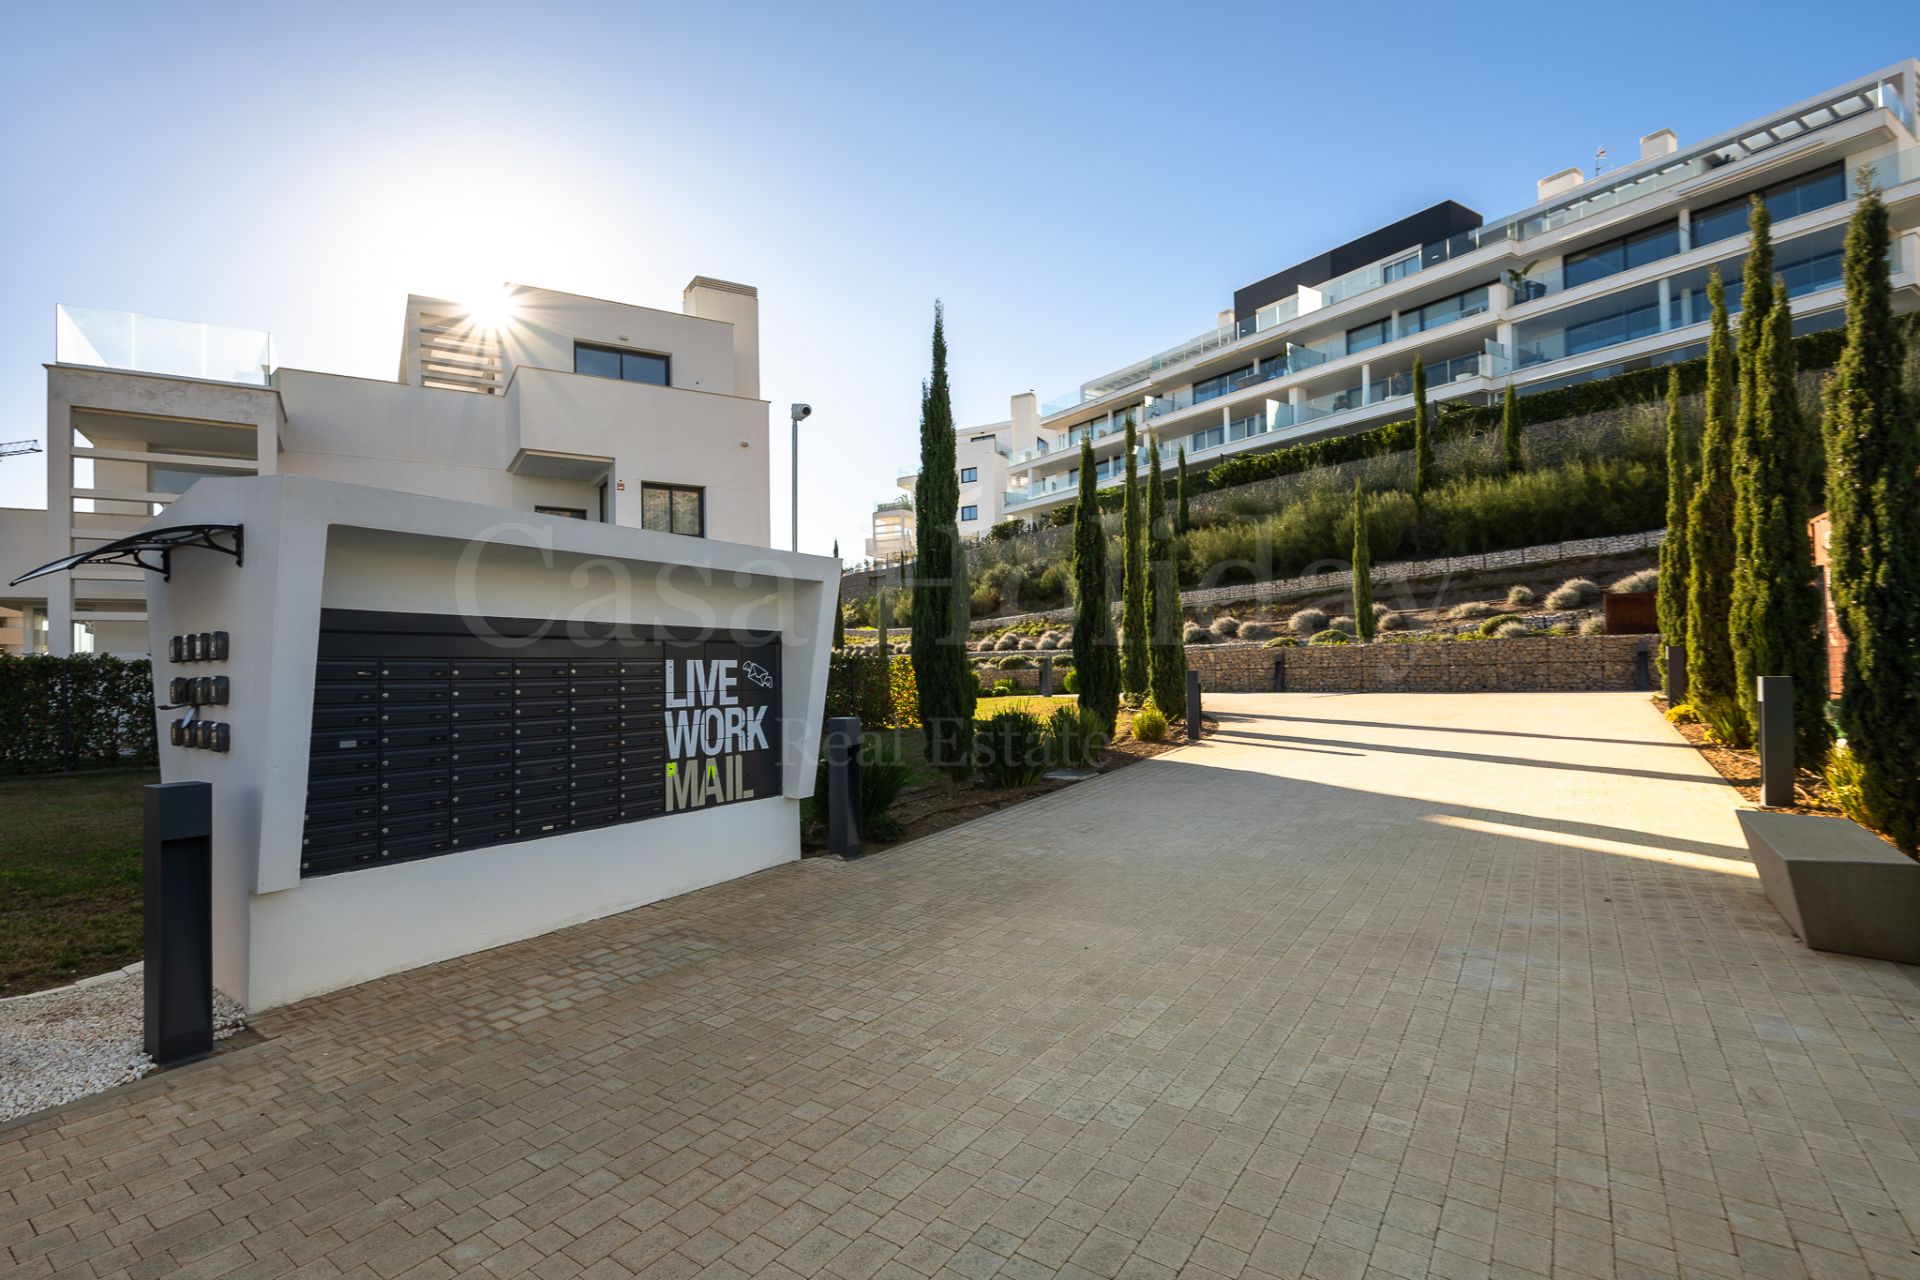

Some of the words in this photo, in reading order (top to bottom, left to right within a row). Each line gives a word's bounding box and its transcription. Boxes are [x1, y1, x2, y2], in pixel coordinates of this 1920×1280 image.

[665, 659, 739, 709] LIVE
[664, 705, 769, 759] WORK
[665, 754, 754, 812] MAIL
